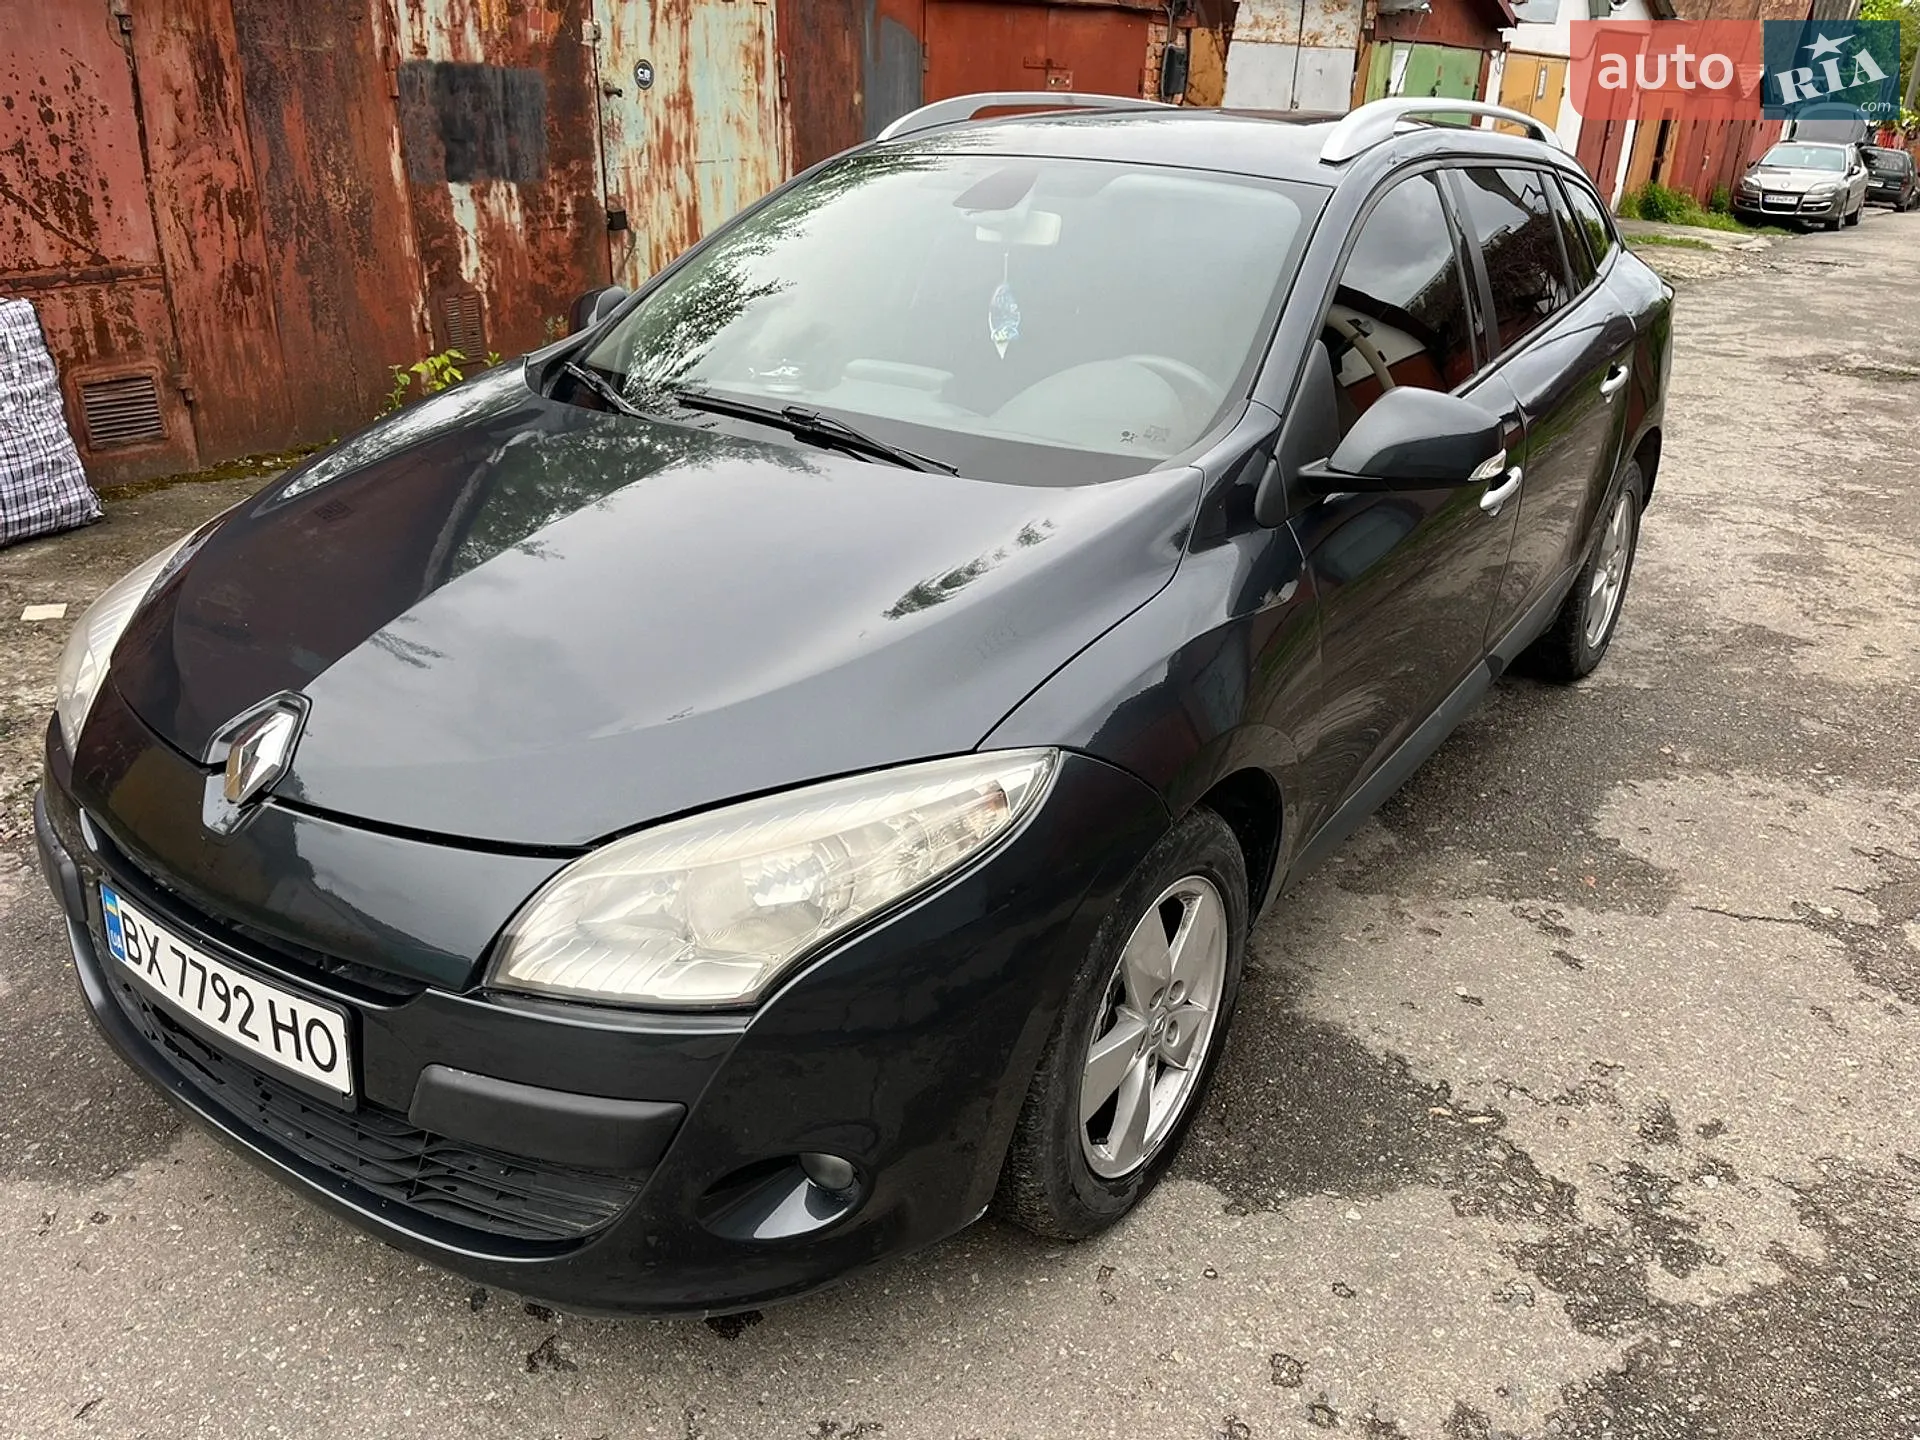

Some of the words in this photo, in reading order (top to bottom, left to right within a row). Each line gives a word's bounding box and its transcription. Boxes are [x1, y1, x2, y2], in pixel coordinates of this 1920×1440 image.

[110, 929, 124, 952] UA
[120, 909, 167, 988] BX
[170, 945, 260, 1043] 7792
[268, 999, 338, 1073] HO
